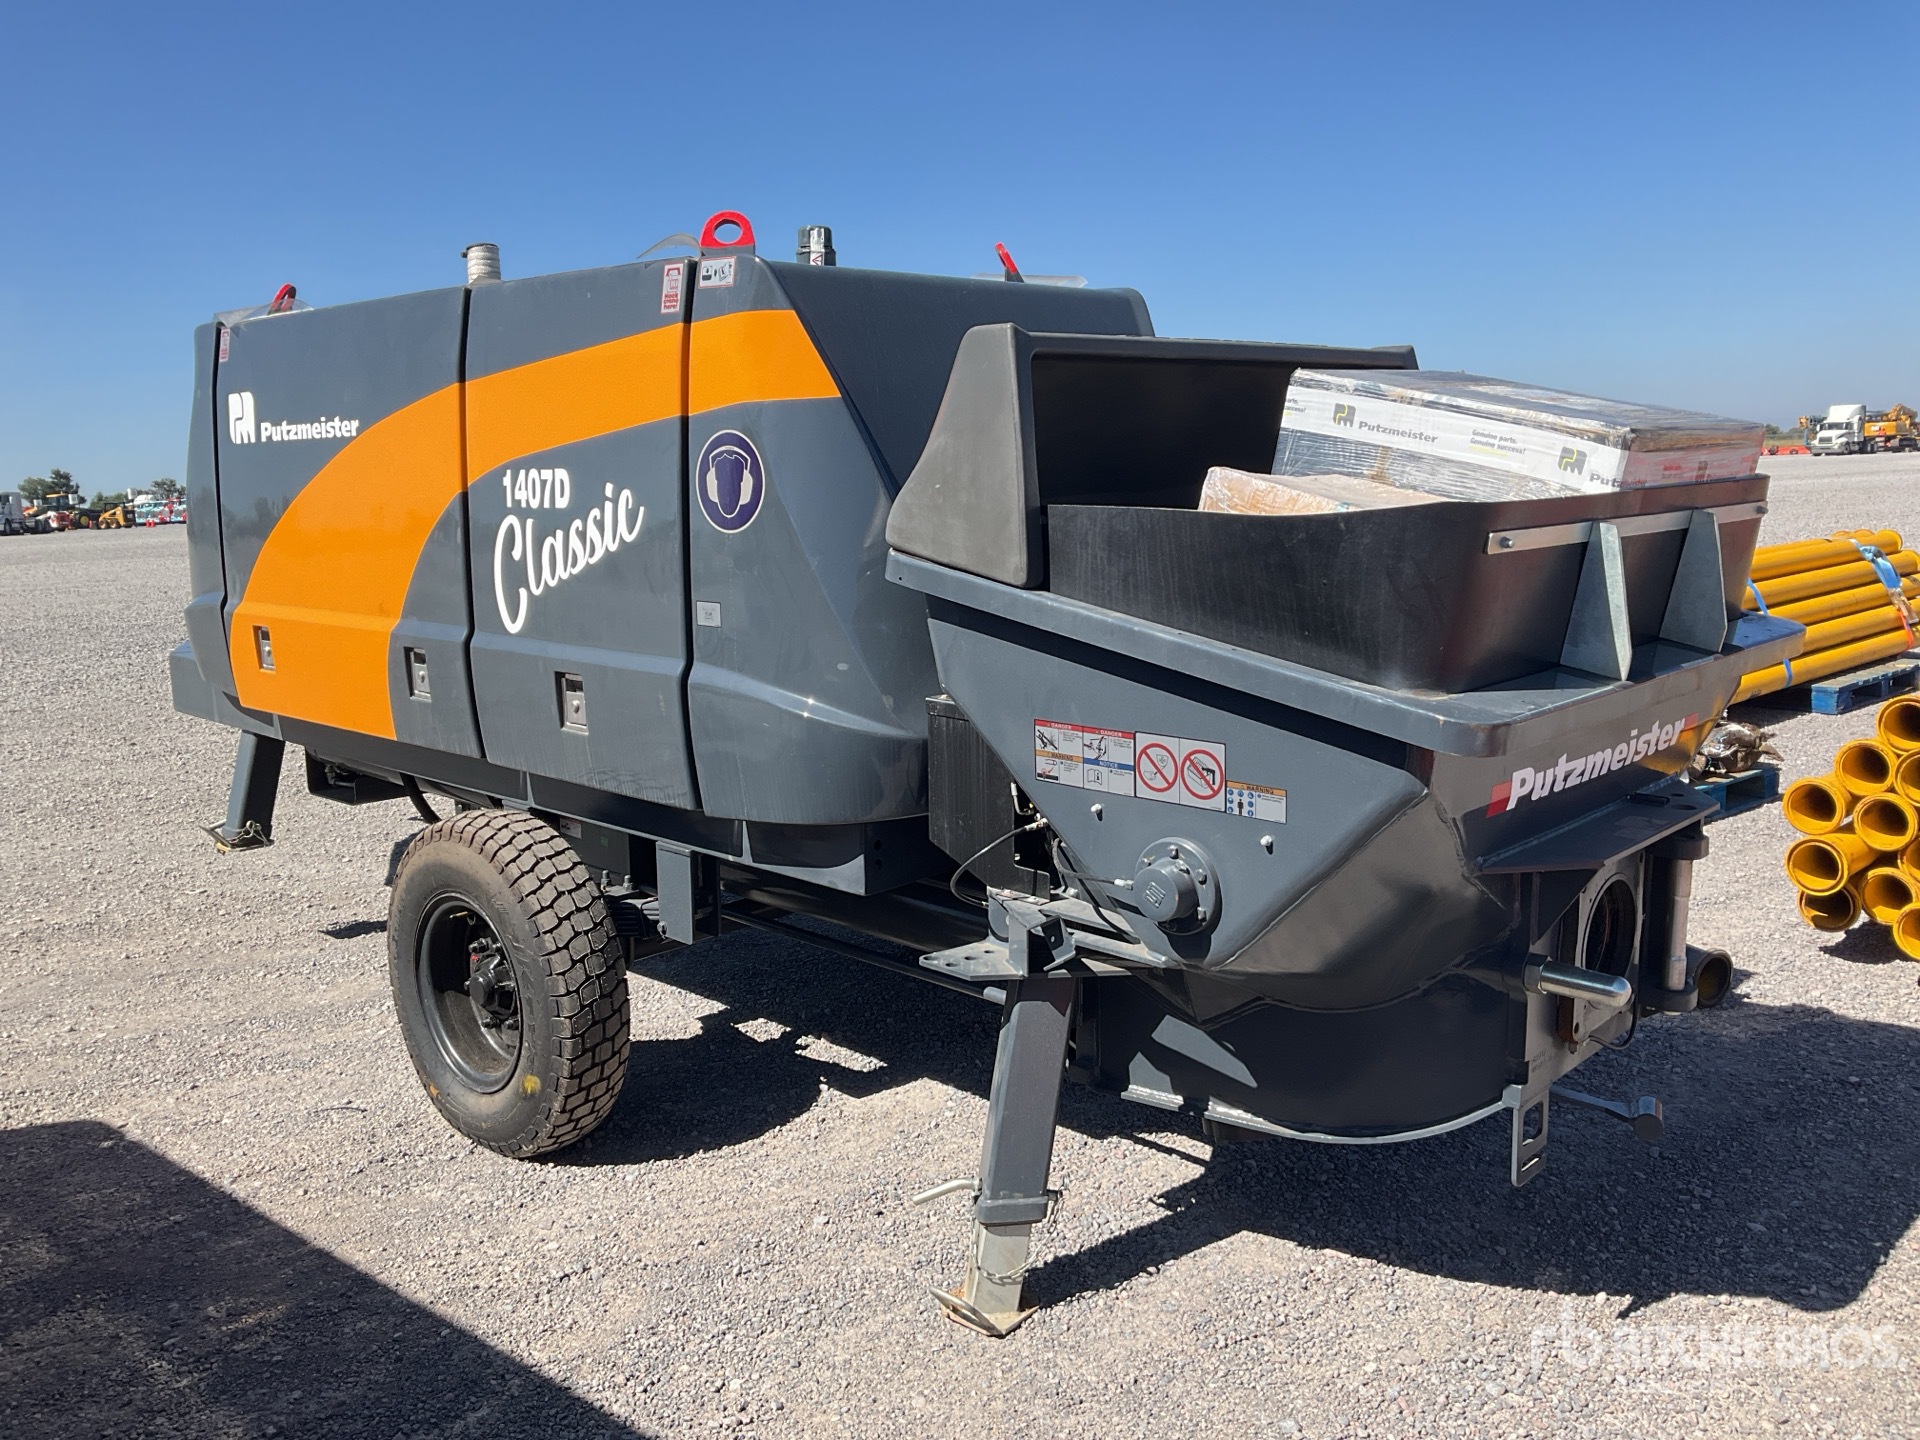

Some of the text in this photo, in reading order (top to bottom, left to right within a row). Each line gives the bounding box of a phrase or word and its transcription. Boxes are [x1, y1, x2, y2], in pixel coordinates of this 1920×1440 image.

[261, 416, 359, 442] Putzmeister
[1357, 421, 1439, 443] Putzmeister
[1472, 430, 1518, 445] Genuine parts.
[1470, 437, 1526, 455] Genuine success!
[503, 468, 571, 509] 1407D
[494, 482, 645, 634] Classic
[1051, 722, 1072, 730] DANGER
[1100, 729, 1123, 738] DANGER
[1050, 751, 1074, 761] WARNING
[1506, 717, 1686, 811] Putzmeister
[1099, 761, 1119, 769] NOTICE
[1246, 785, 1275, 794] WARNING
